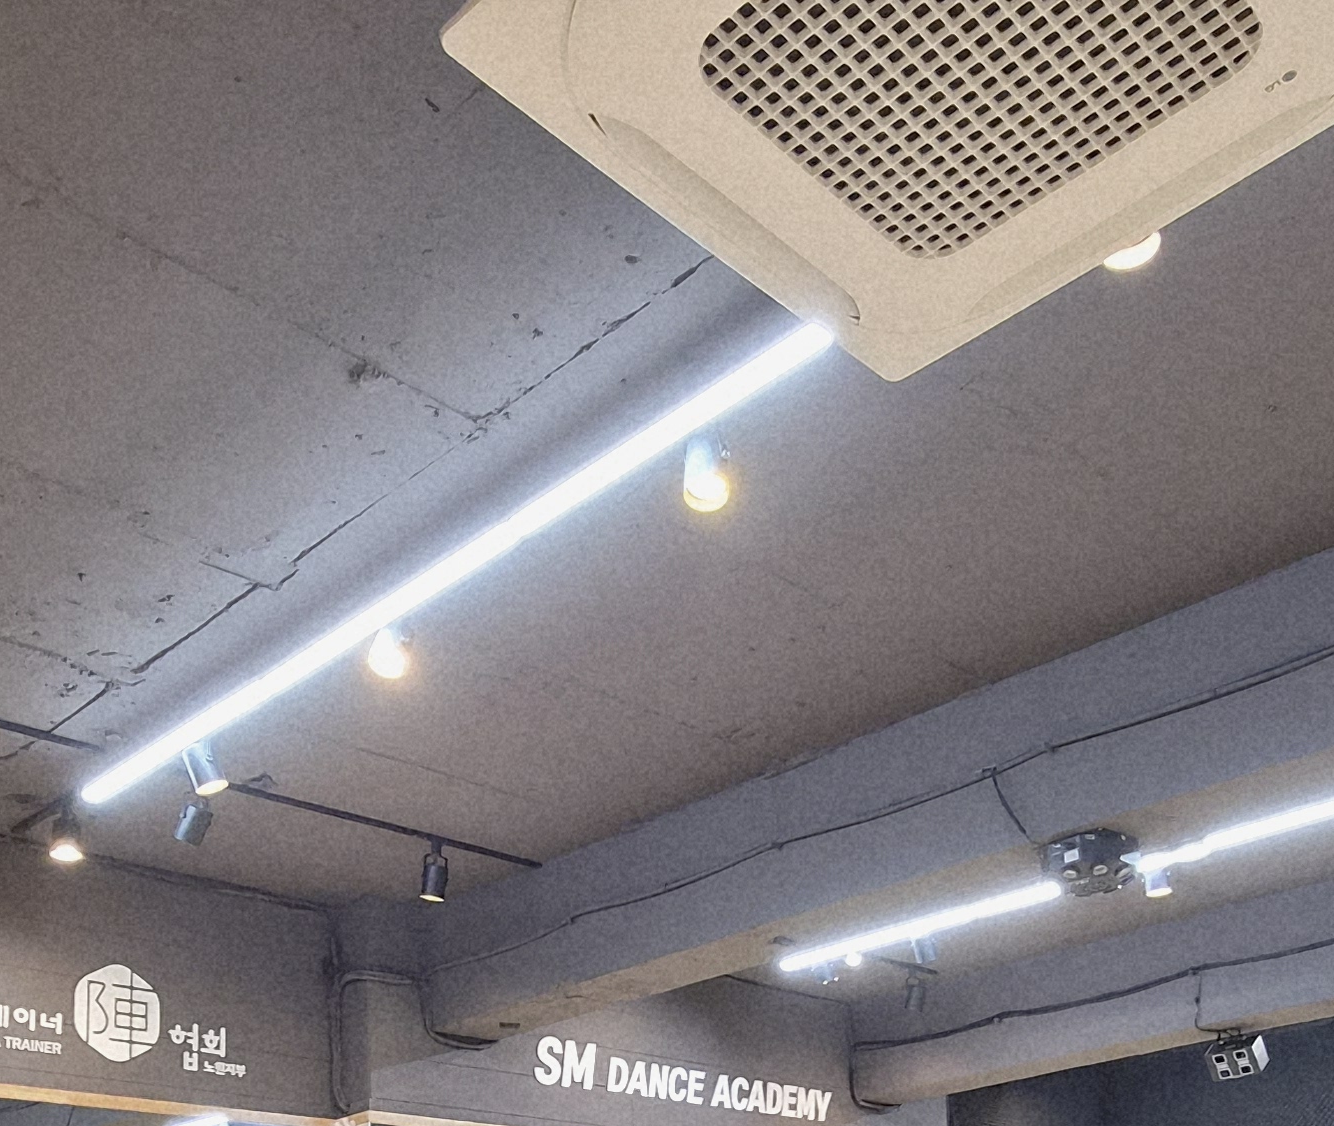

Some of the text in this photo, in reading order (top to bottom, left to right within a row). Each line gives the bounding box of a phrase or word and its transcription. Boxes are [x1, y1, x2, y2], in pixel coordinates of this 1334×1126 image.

[5, 1036, 62, 1055] TRAINER
[168, 1023, 226, 1071] 협회
[533, 1036, 832, 1122] SM DANCE ACADEMY
